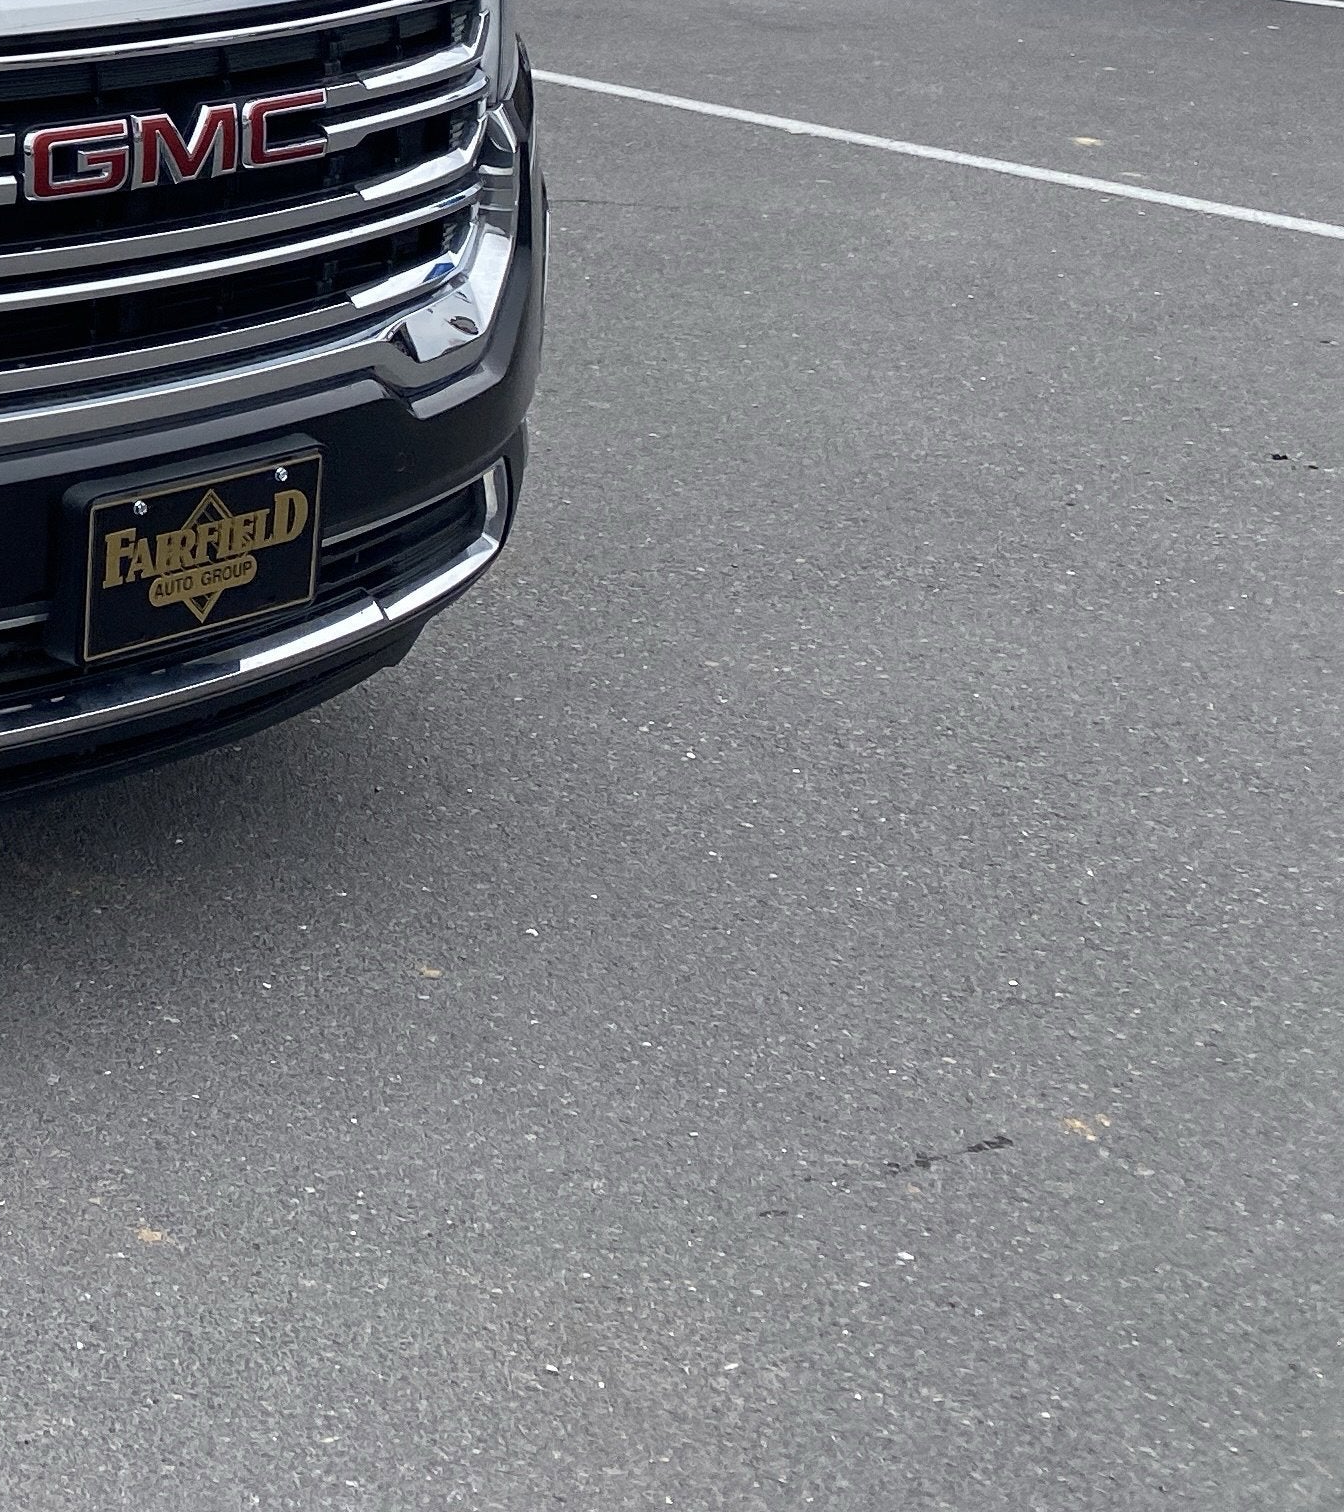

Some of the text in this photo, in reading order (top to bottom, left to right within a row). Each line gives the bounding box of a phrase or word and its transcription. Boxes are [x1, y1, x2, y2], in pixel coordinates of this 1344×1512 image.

[23, 88, 329, 202] GMC
[102, 488, 309, 589] FAIRFIELD
[154, 560, 254, 599] AUTO GROUP
